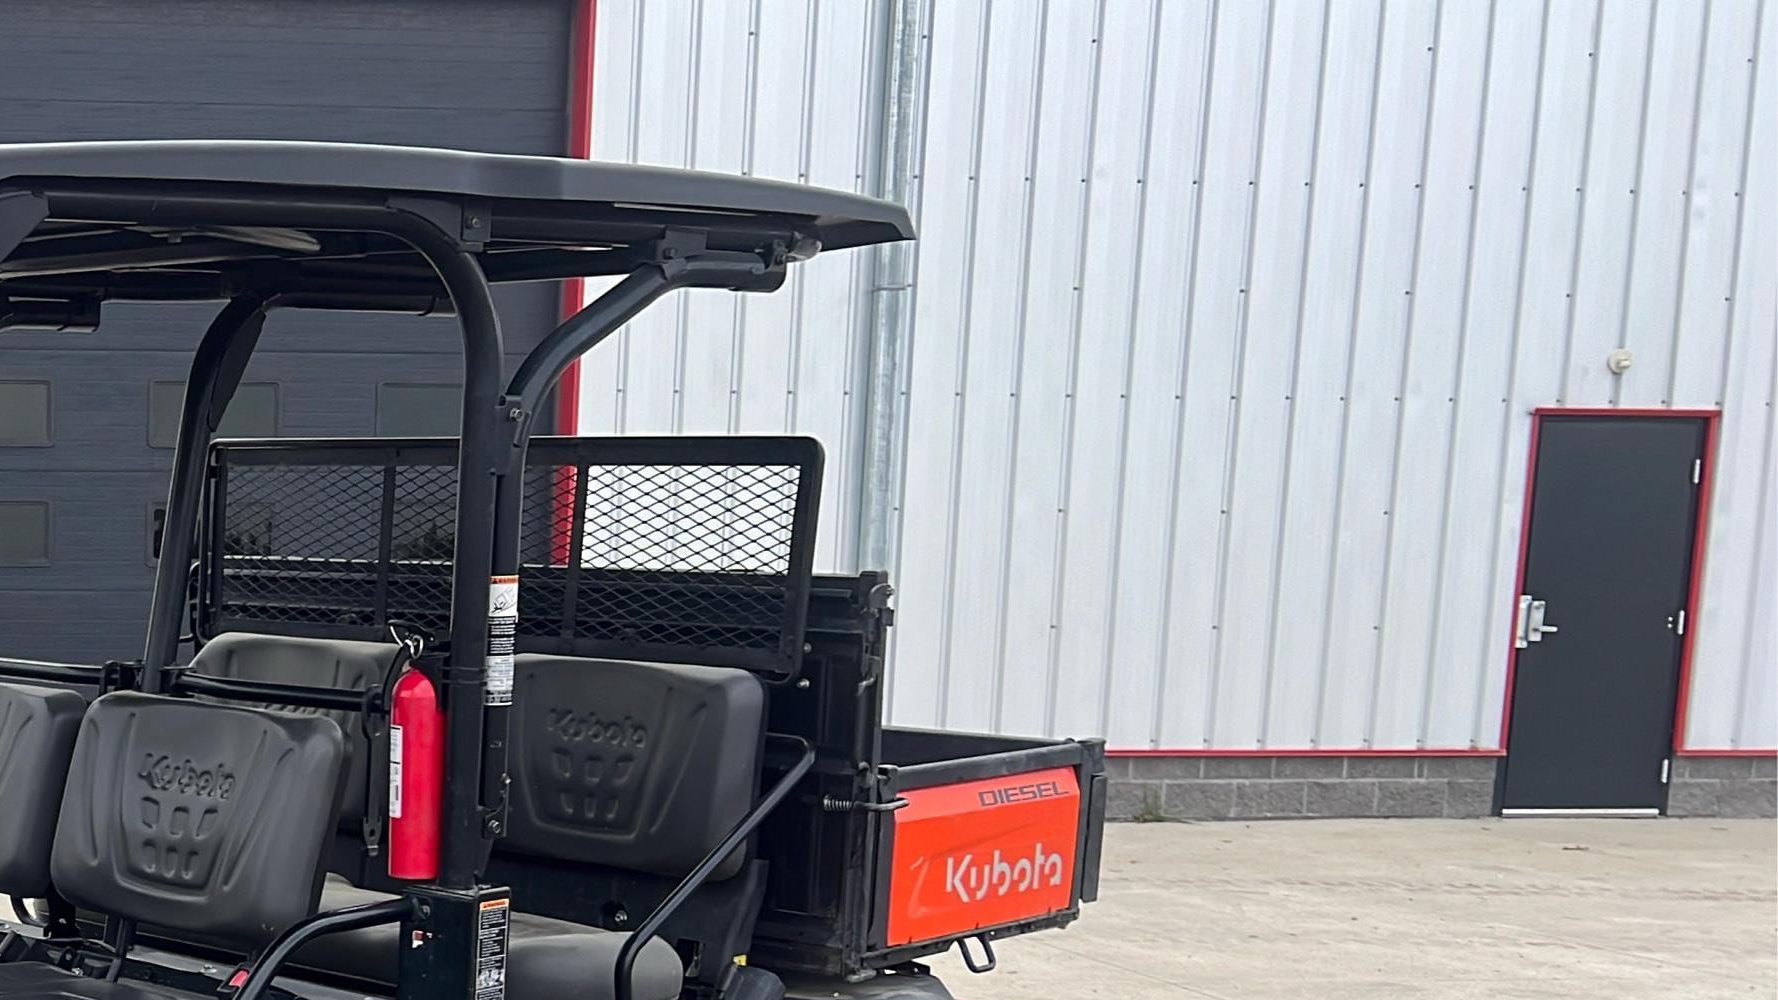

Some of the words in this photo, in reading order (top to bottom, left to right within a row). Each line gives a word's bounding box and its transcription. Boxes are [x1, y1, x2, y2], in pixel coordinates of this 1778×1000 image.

[547, 707, 647, 749] Kubota
[138, 752, 236, 801] Kubota
[978, 781, 1070, 807] DIESEL
[944, 843, 1063, 903] Kubota
